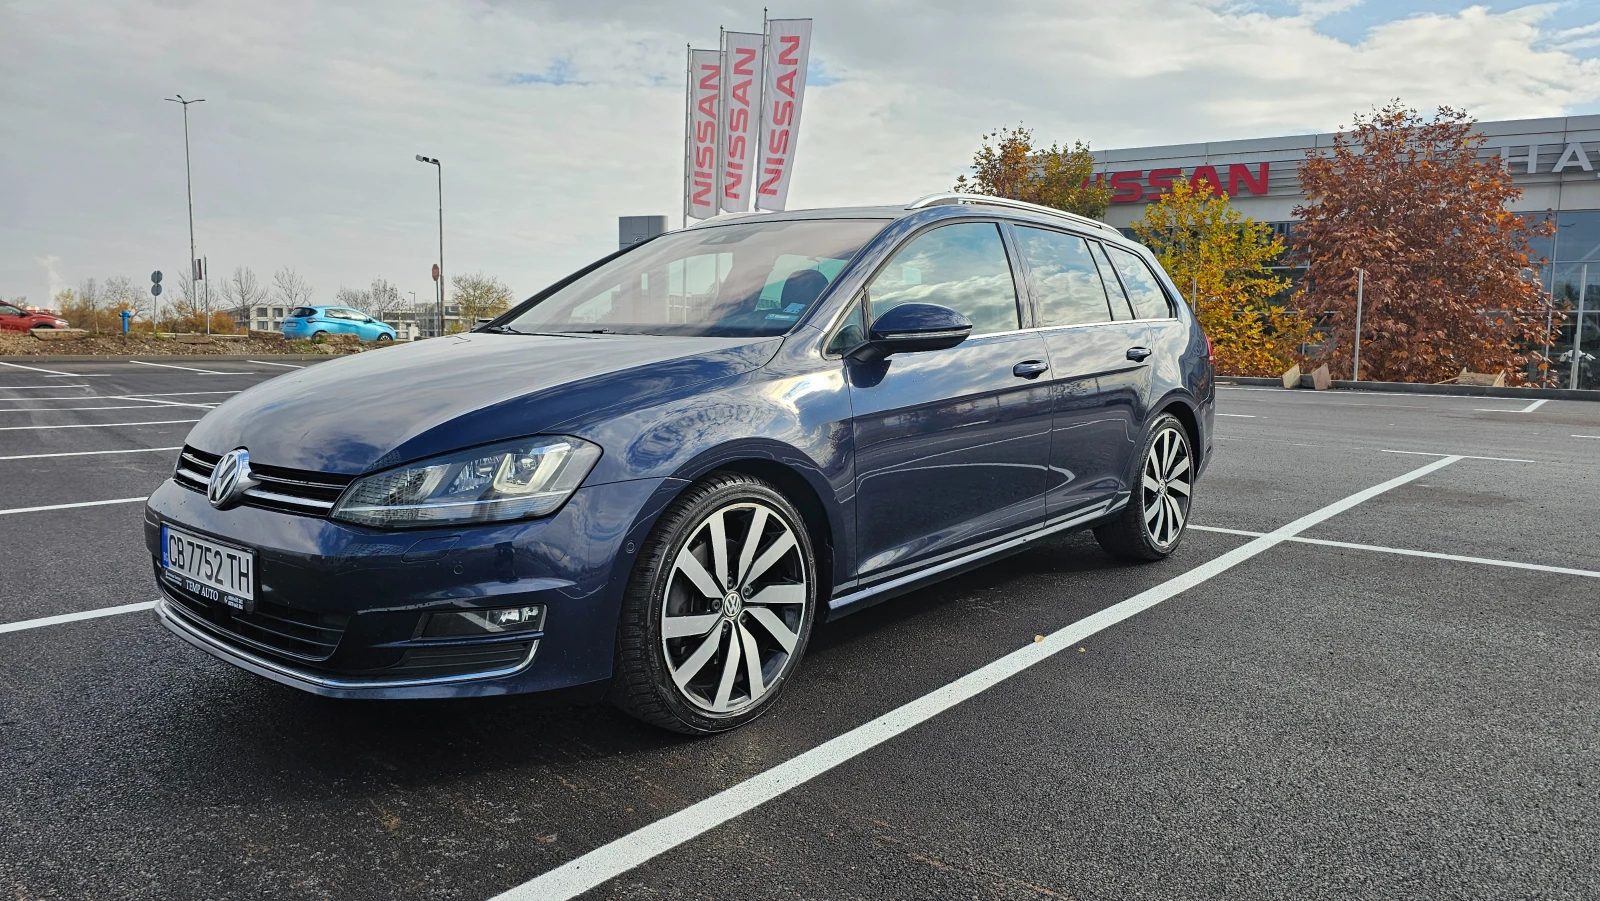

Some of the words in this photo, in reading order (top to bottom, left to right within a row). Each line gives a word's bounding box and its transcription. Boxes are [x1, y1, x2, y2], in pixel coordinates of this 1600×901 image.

[692, 64, 721, 206] NISSAN
[724, 48, 757, 199] NISSAN
[758, 36, 801, 196] NISSAN
[187, 541, 224, 585] 7752
[227, 552, 250, 594] TH
[201, 586, 219, 601] AUTO
